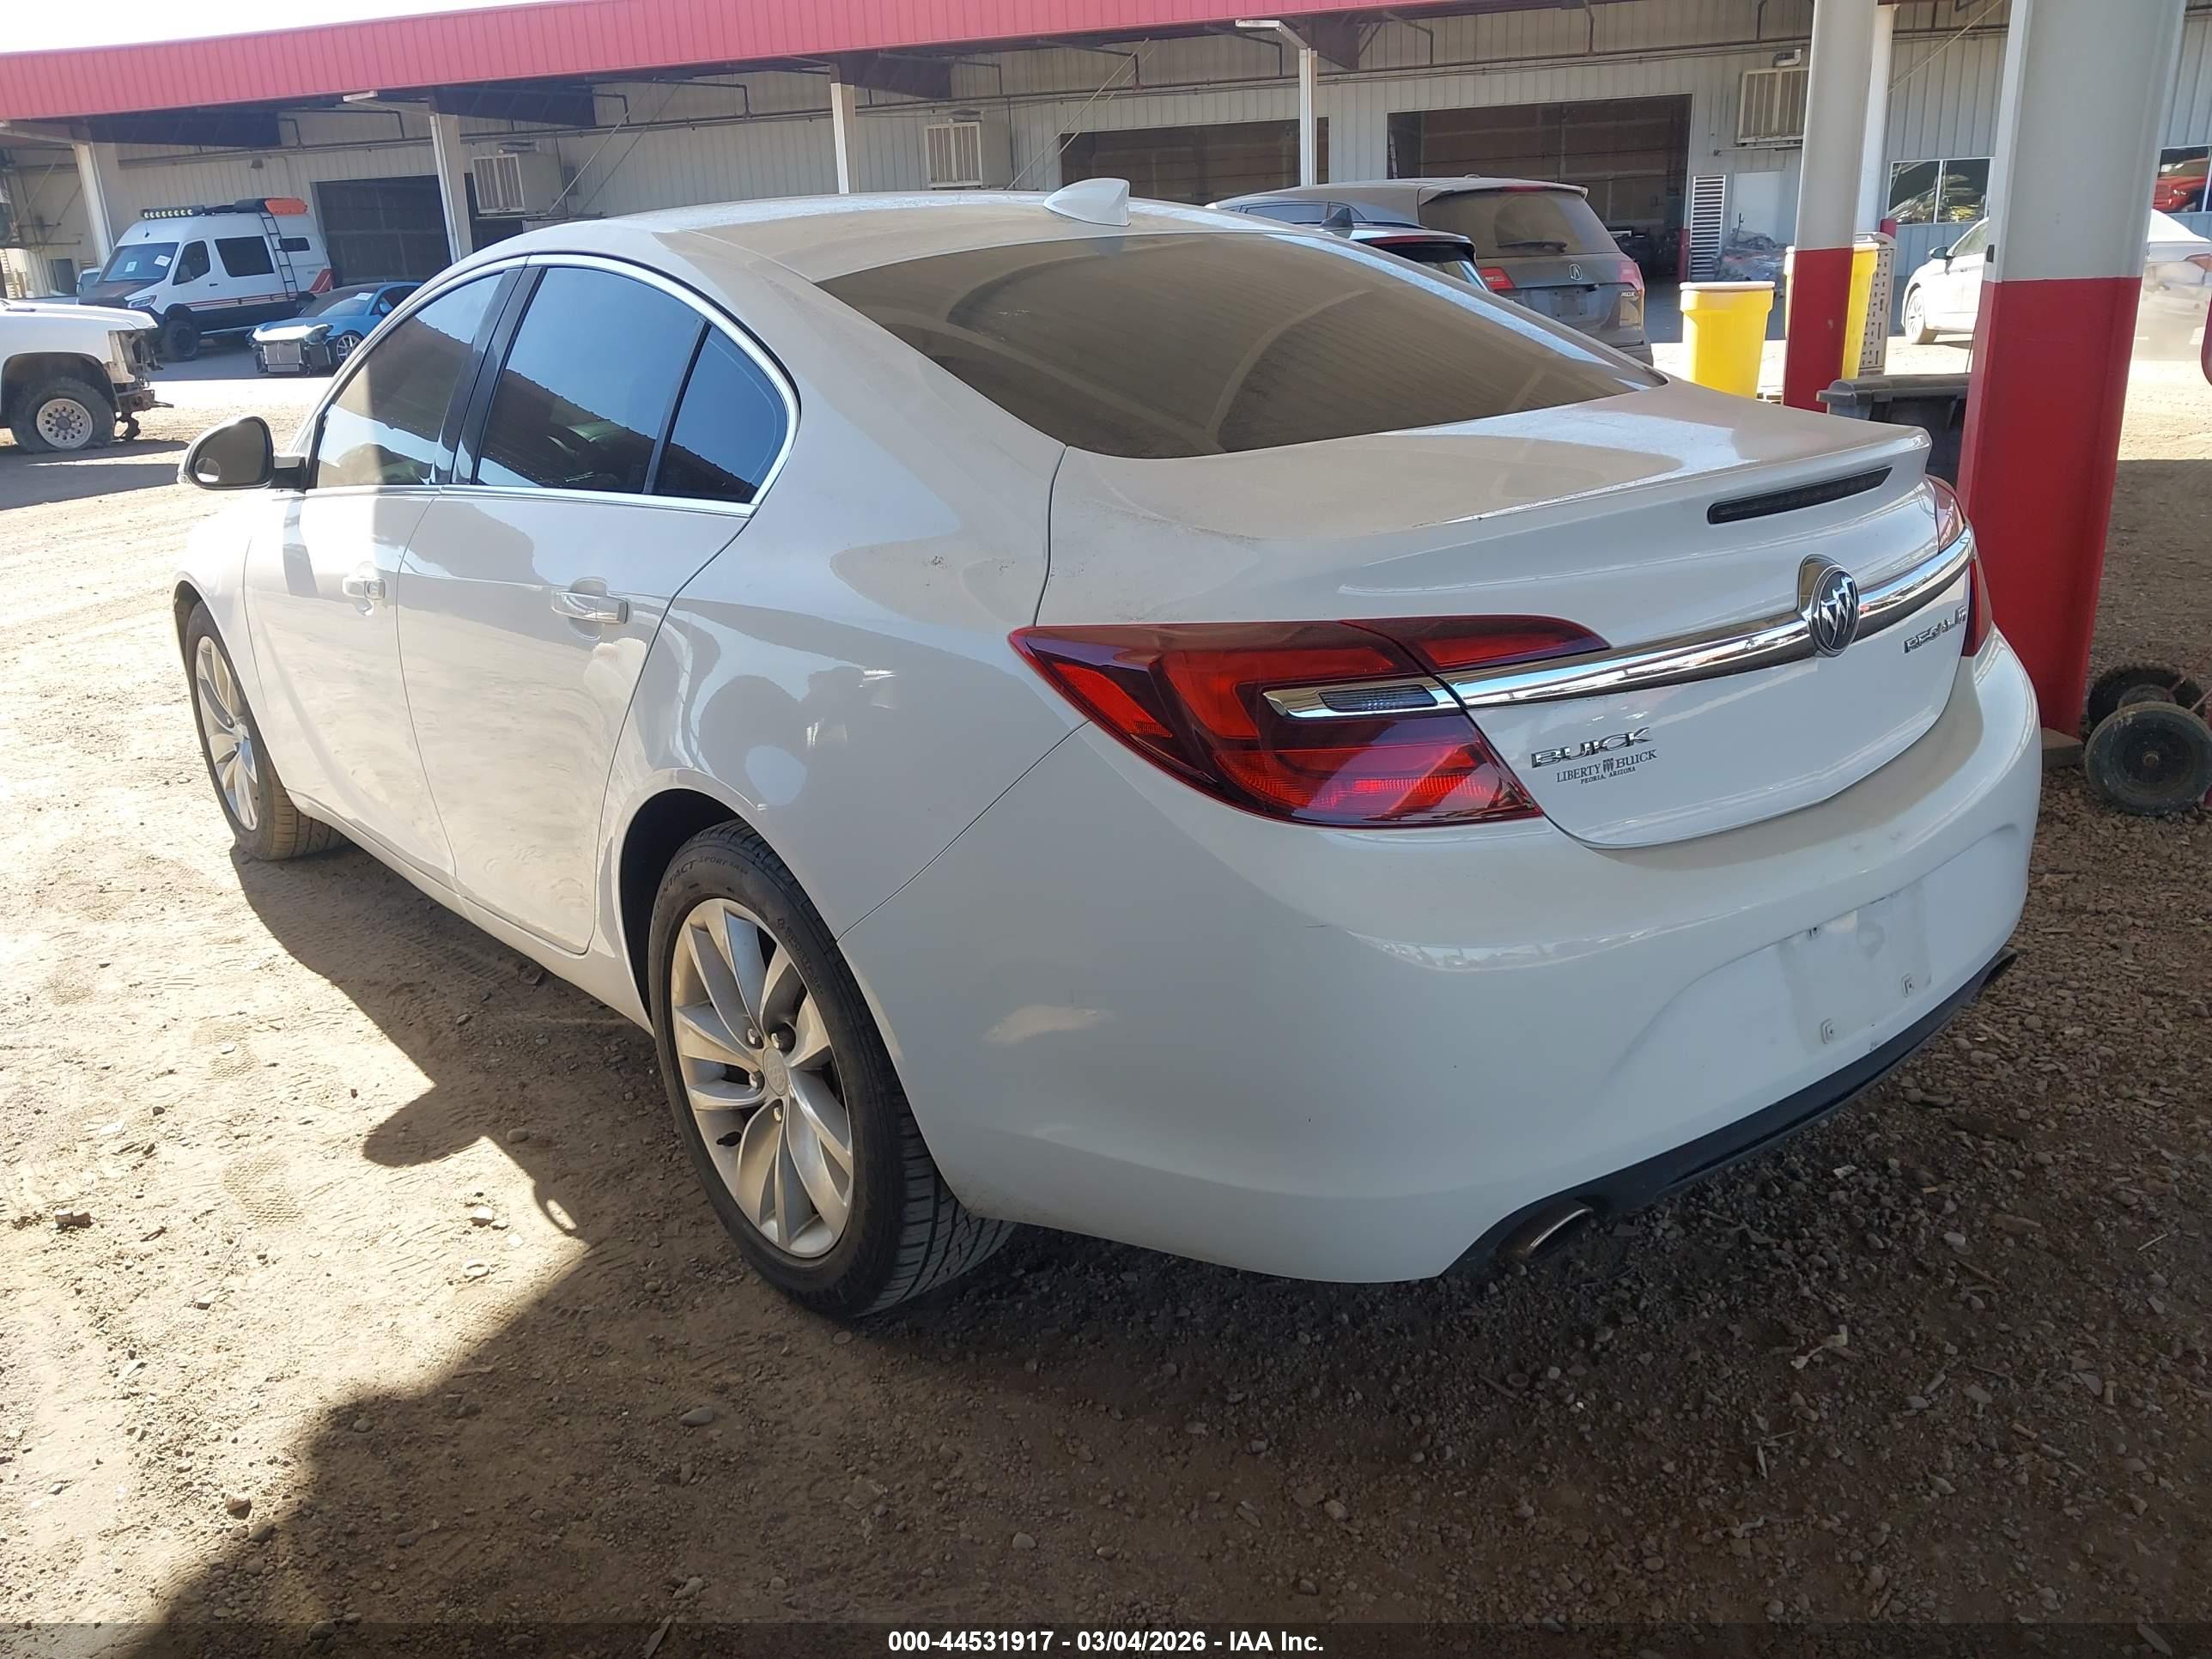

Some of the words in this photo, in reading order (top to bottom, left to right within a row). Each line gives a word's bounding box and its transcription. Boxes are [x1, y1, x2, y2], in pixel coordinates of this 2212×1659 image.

[1531, 726, 1653, 769] BUICK
[1556, 763, 1601, 783] LIBERTY
[1615, 748, 1658, 769] BUICK
[1580, 774, 1607, 785] PEORIA,
[1608, 766, 1636, 778] ARIZONA
